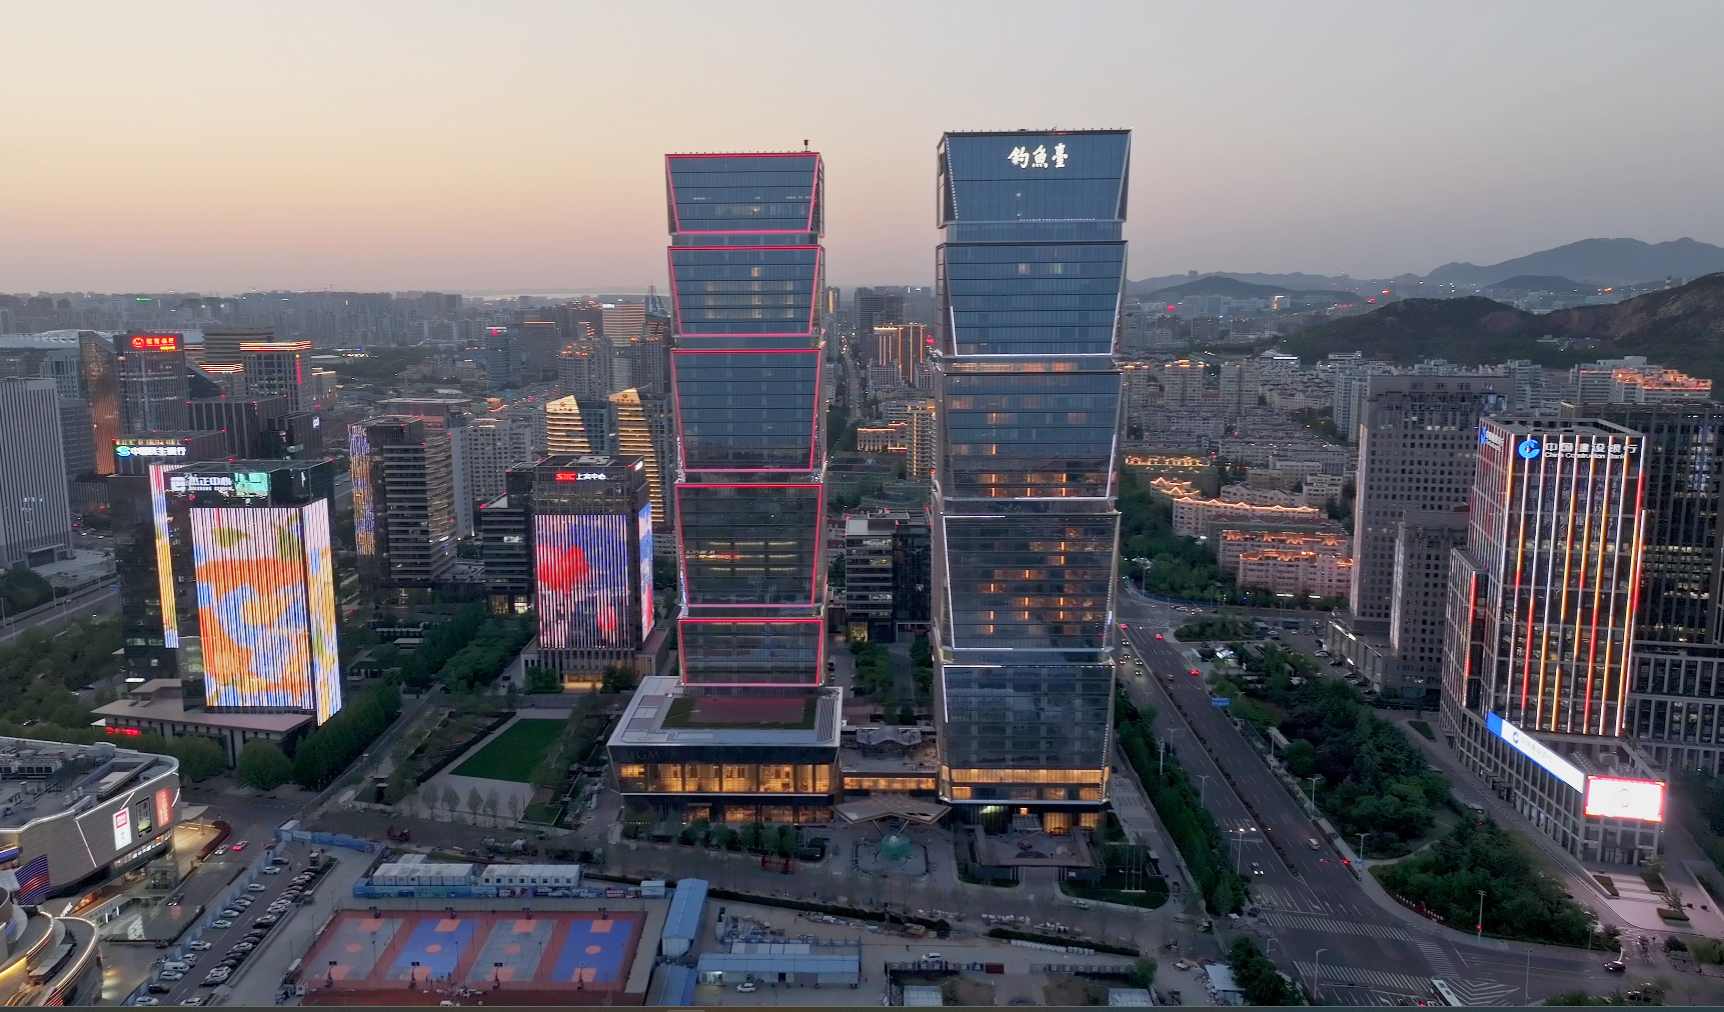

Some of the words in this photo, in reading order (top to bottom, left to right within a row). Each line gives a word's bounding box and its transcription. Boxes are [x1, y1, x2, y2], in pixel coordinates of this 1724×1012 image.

[1545, 442, 1638, 454] 中国建设银行
